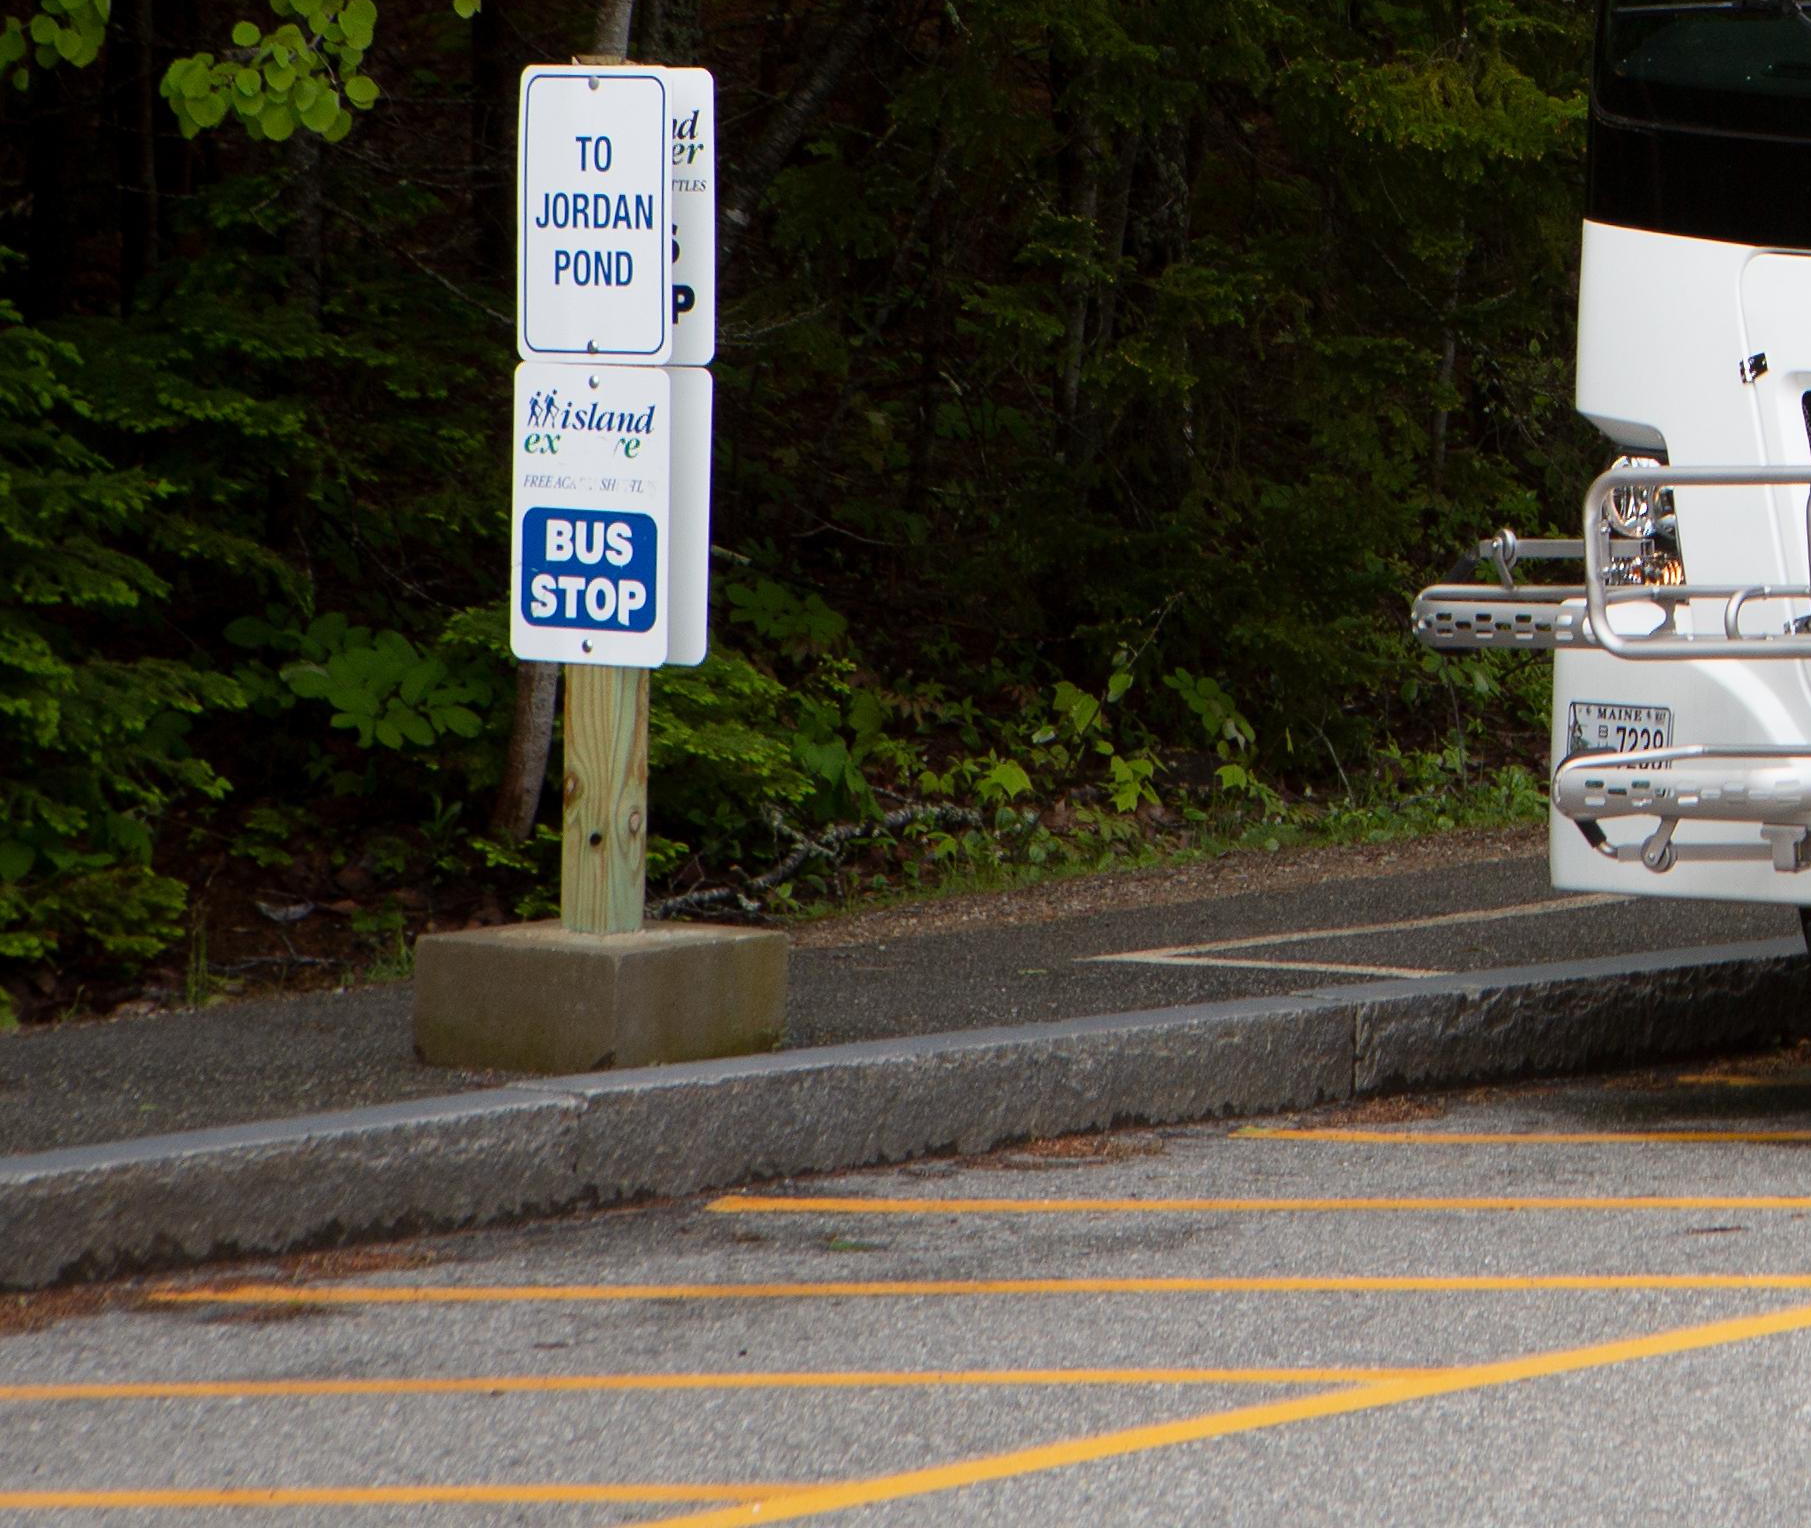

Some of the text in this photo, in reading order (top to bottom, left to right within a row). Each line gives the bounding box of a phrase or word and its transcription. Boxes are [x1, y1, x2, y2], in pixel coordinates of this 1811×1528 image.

[575, 135, 613, 172] TO
[536, 193, 654, 230] JORDAN
[554, 250, 634, 287] POND
[560, 401, 656, 435] island
[523, 474, 554, 490] FREE
[545, 519, 634, 567] BUS
[530, 574, 647, 626] STOP
[1597, 707, 1642, 721] MAINE
